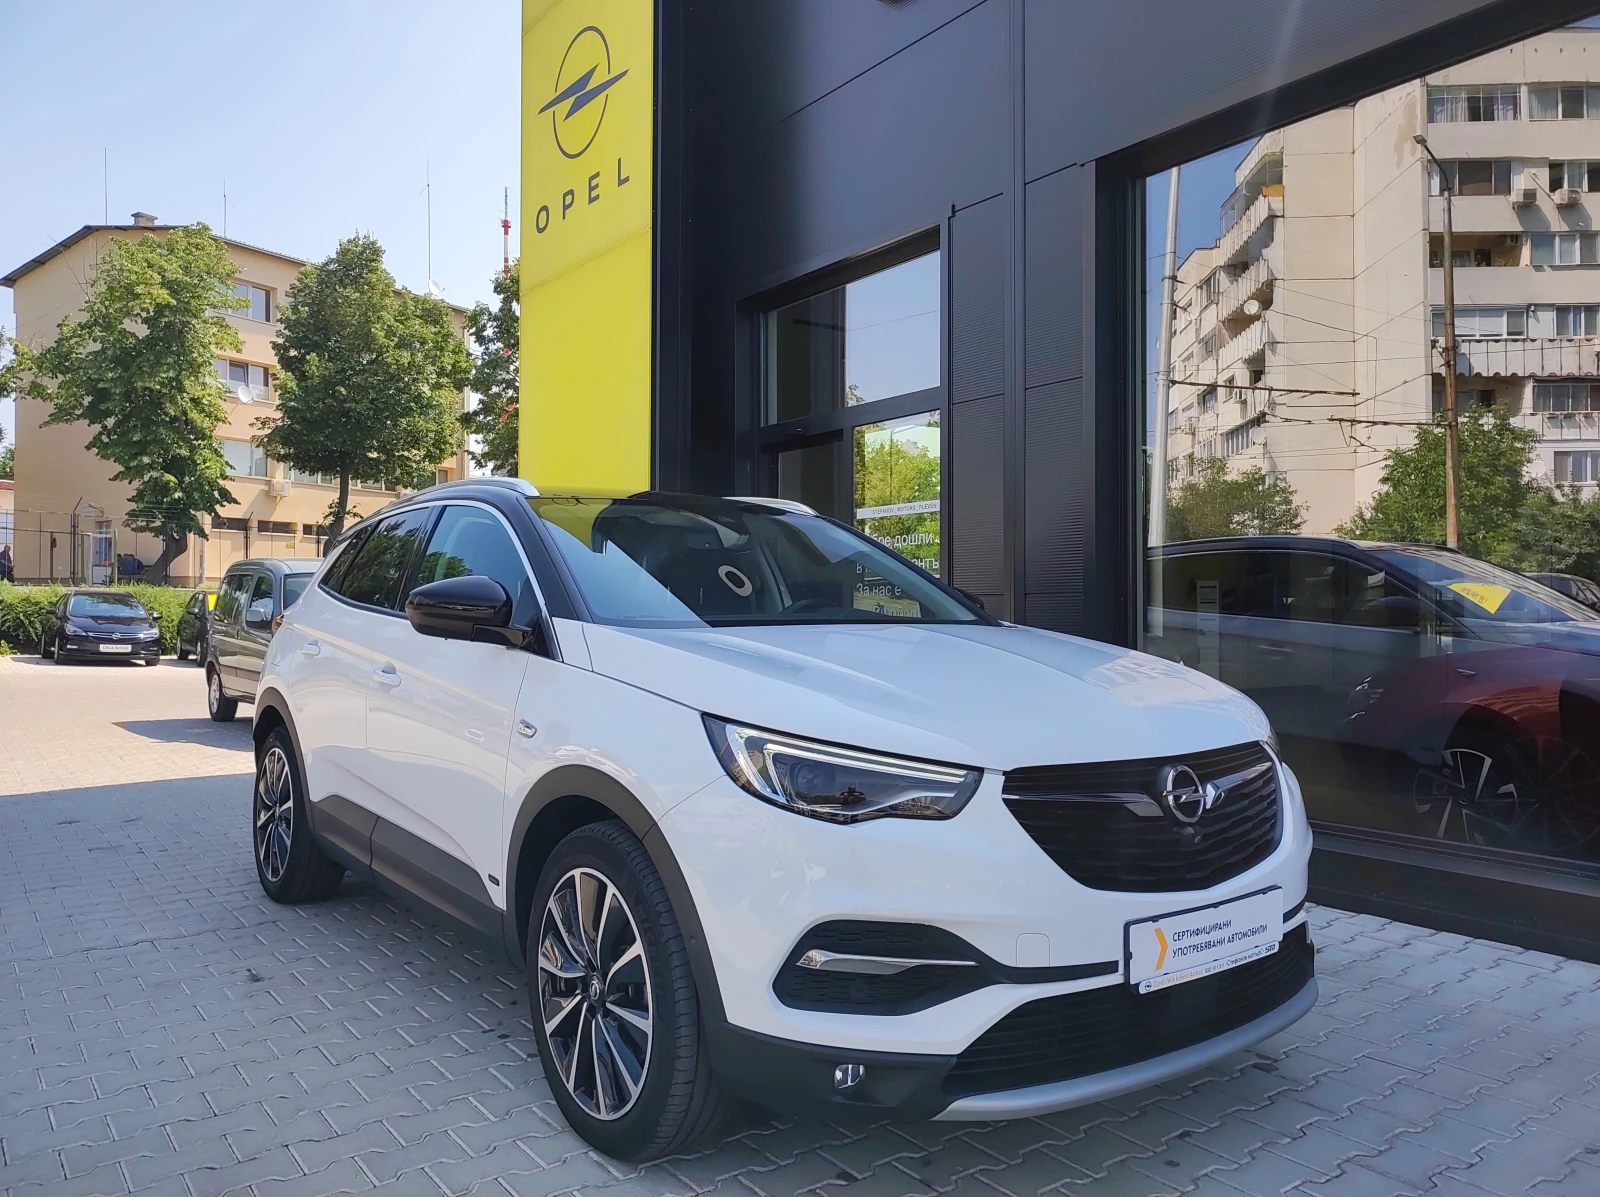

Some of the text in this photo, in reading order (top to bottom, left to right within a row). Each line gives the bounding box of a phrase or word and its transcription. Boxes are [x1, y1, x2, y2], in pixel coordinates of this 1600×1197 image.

[536, 157, 629, 234] OPEL
[893, 532, 933, 549] дошли
[856, 583, 870, 597] За
[872, 585, 892, 596] нас
[1172, 918, 1232, 942] СЕРТИФИЦИРАНИ
[1172, 923, 1268, 959] УПОТРЕБЯВАНИ АВТОМОБИЛИ
